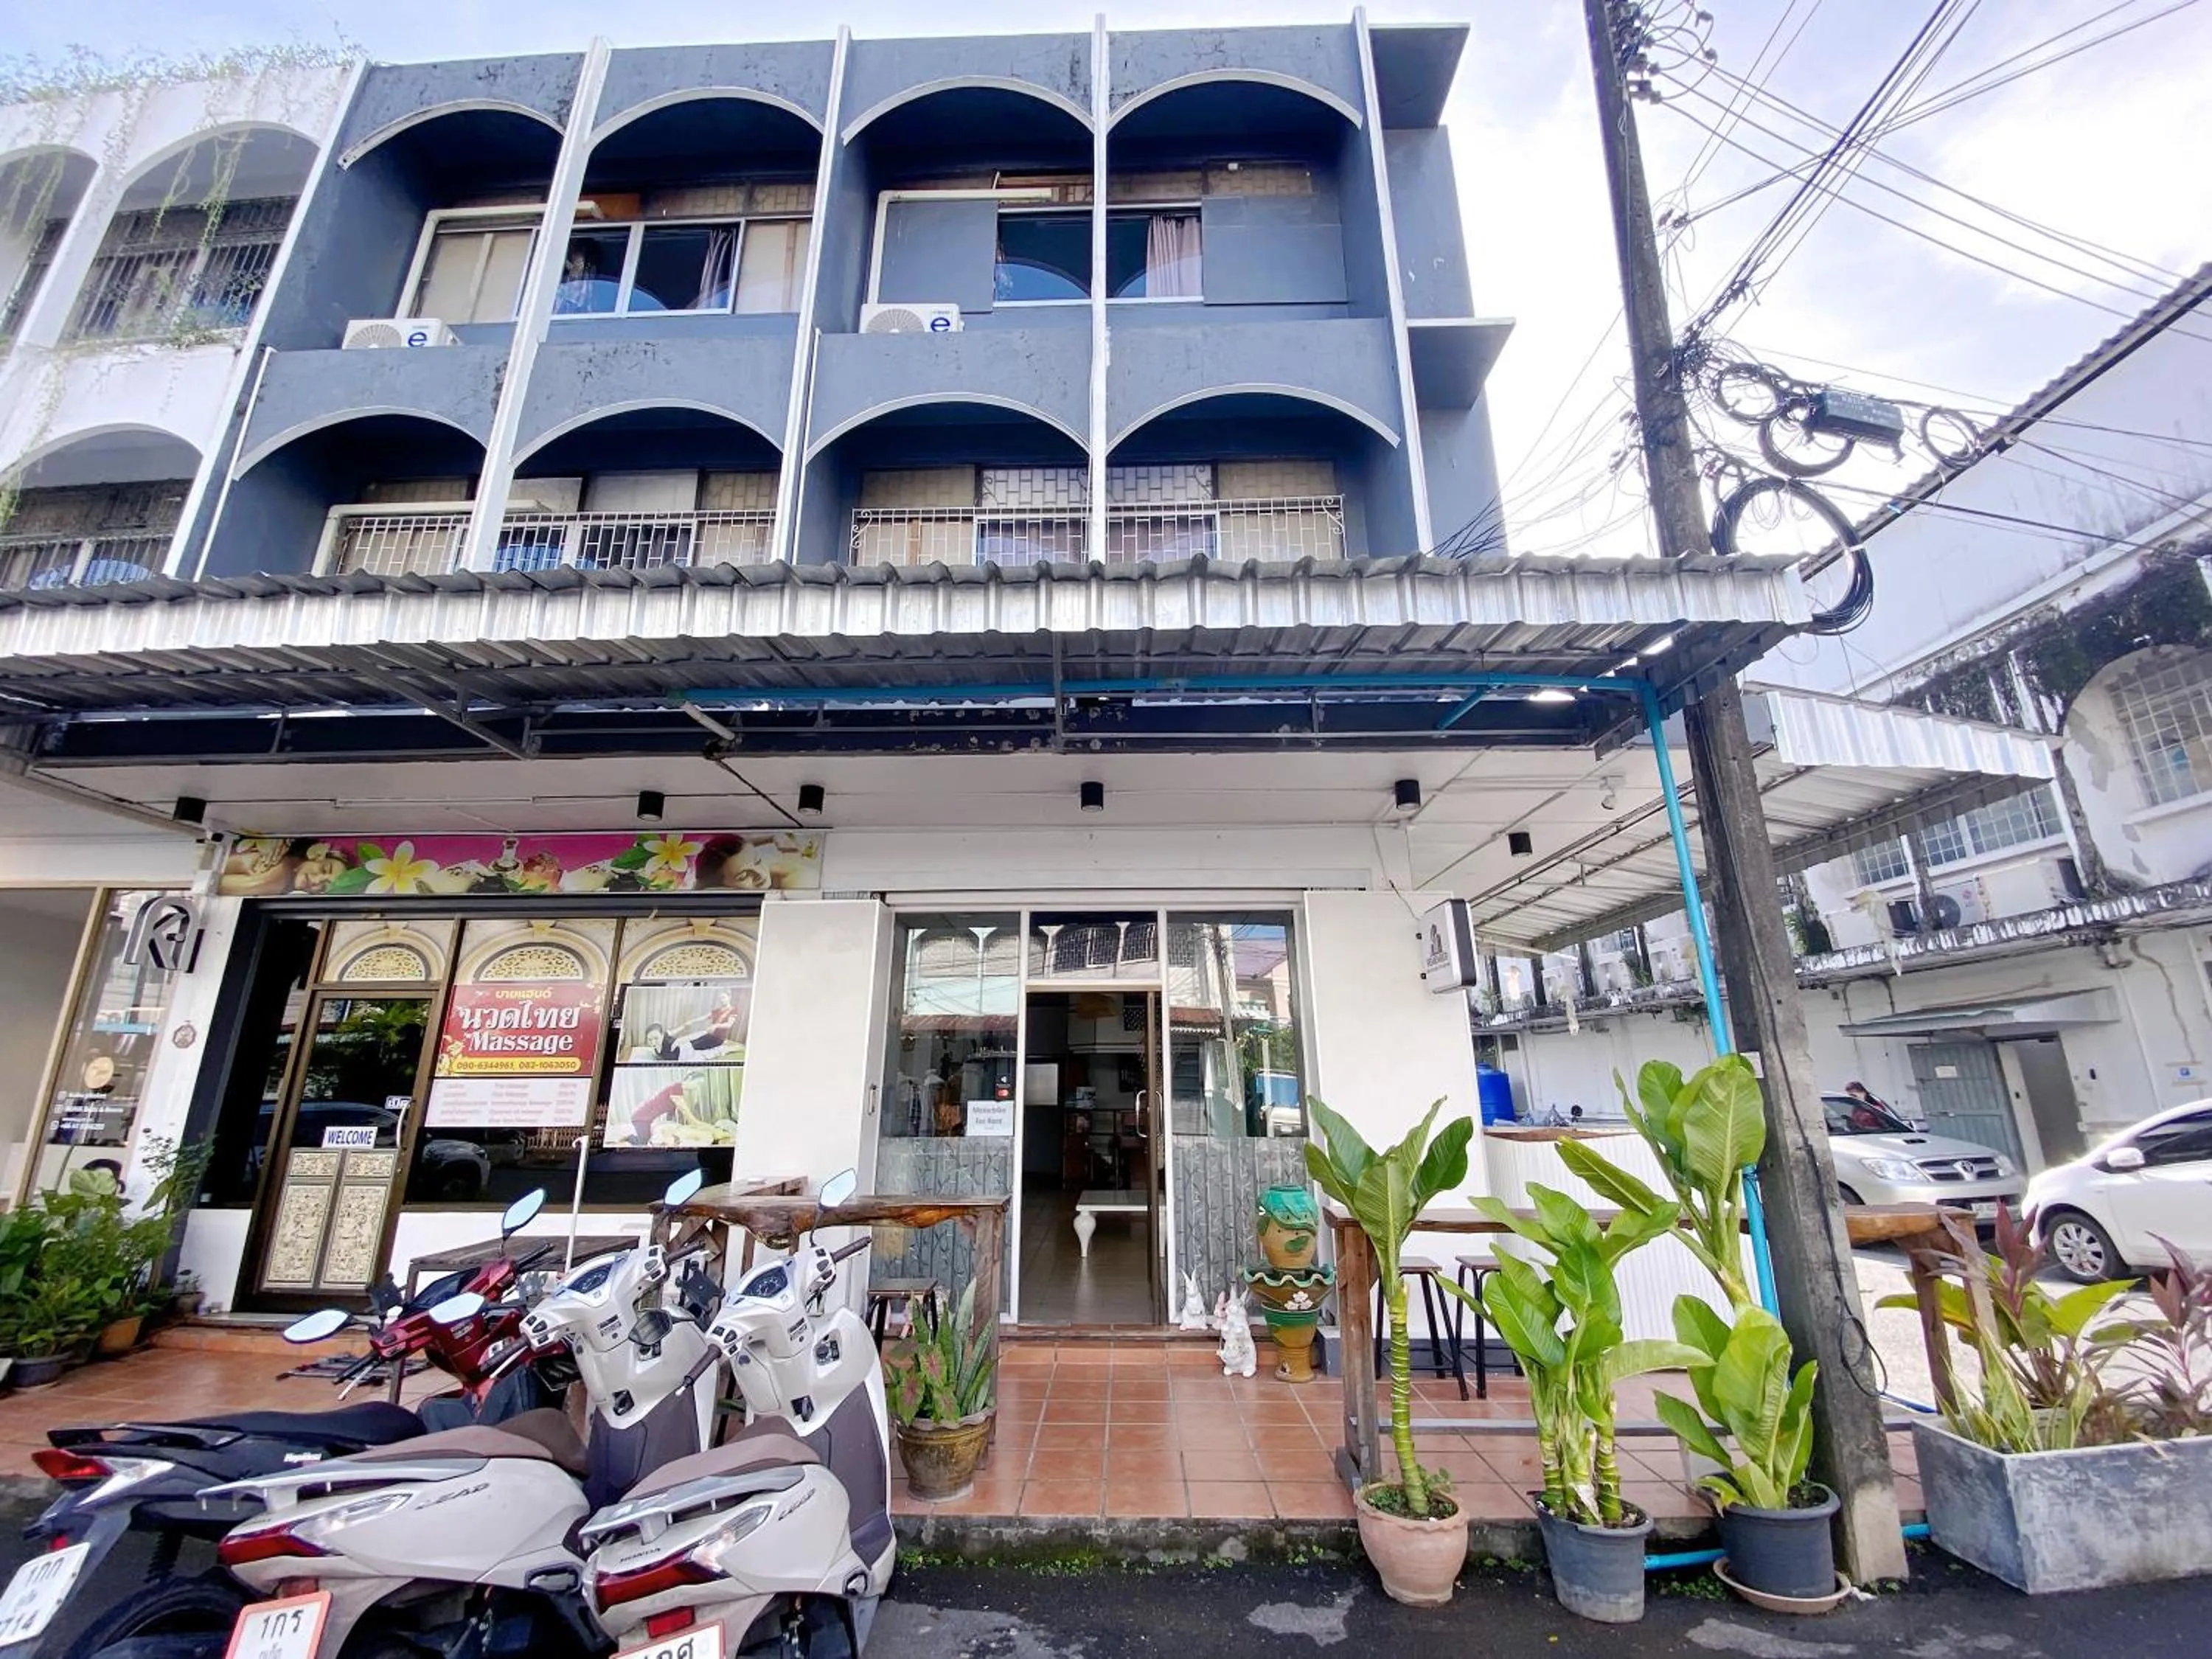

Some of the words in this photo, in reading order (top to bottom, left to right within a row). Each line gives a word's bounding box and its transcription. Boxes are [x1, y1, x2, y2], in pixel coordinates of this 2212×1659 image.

[457, 1000, 582, 1029] นวดไทย
[464, 1030, 574, 1054] Massage
[328, 1130, 374, 1145] WELCOME
